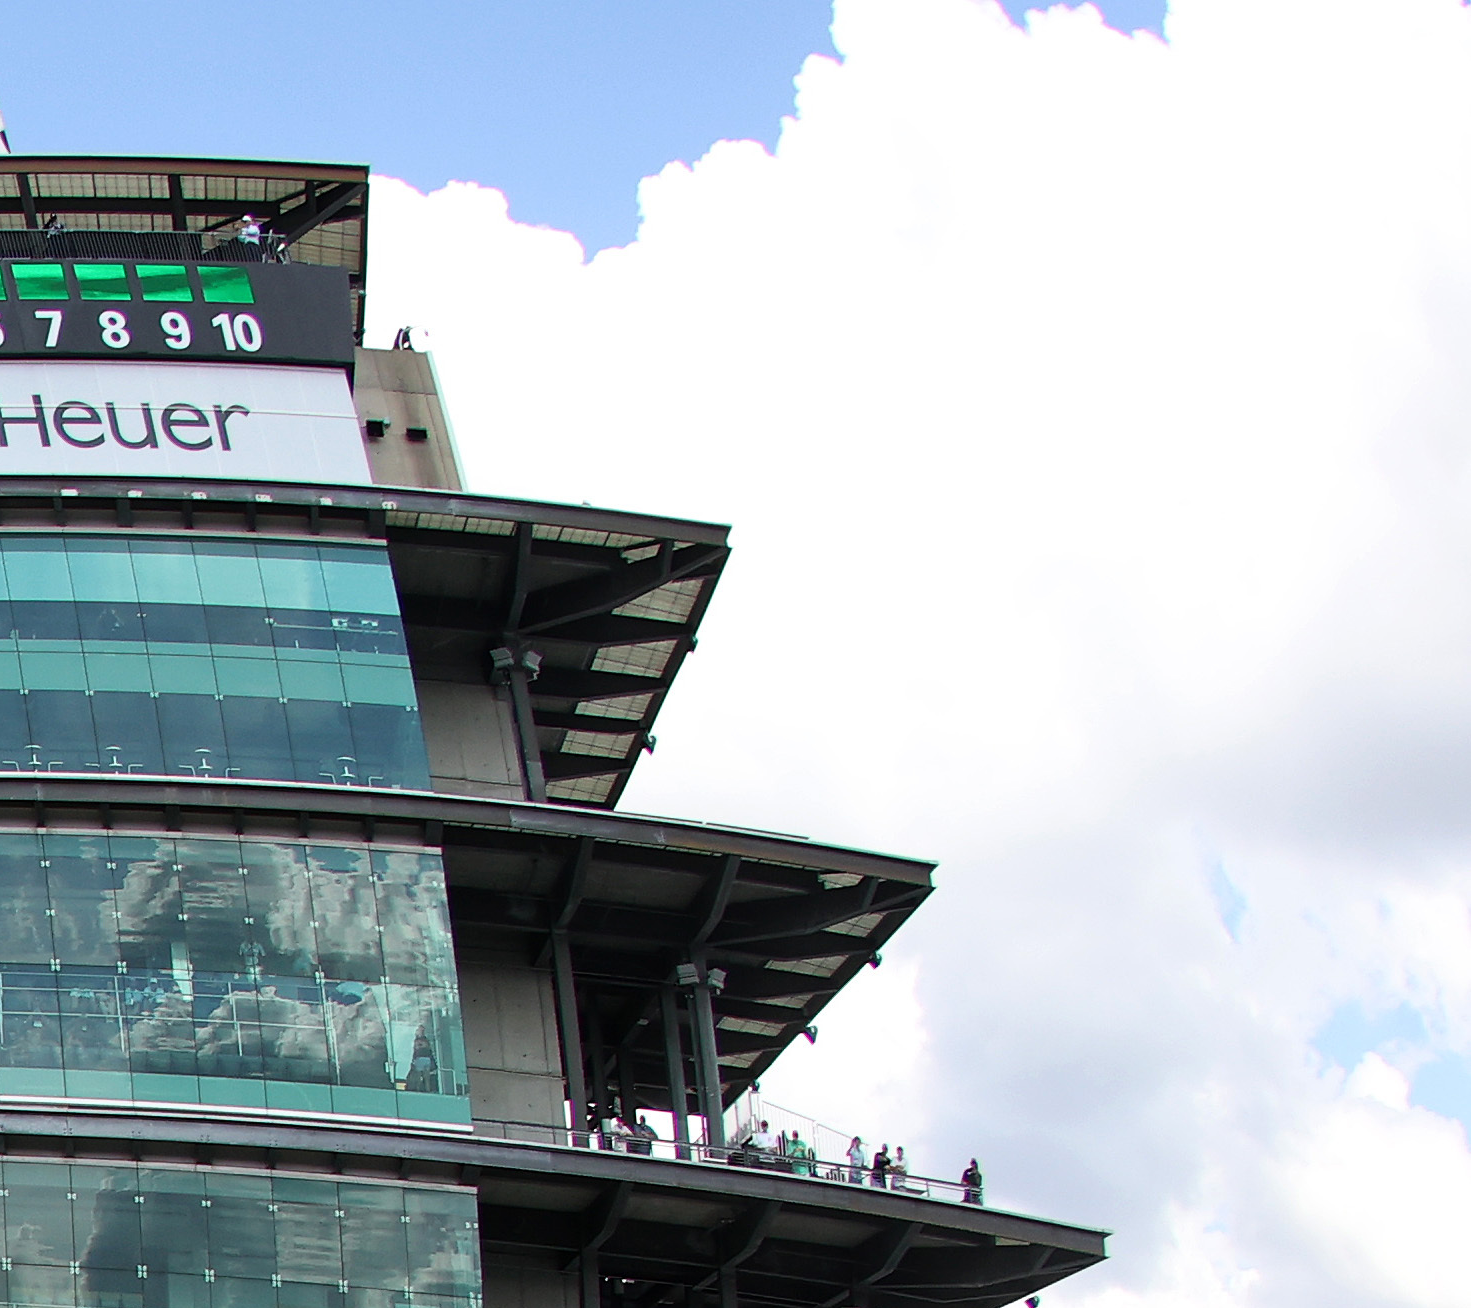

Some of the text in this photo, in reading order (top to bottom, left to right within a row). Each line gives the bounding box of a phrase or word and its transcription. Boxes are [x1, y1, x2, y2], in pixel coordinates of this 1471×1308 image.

[34, 311, 63, 347] 7
[98, 311, 130, 349] 8
[161, 311, 191, 349] 9
[212, 312, 262, 353] 10
